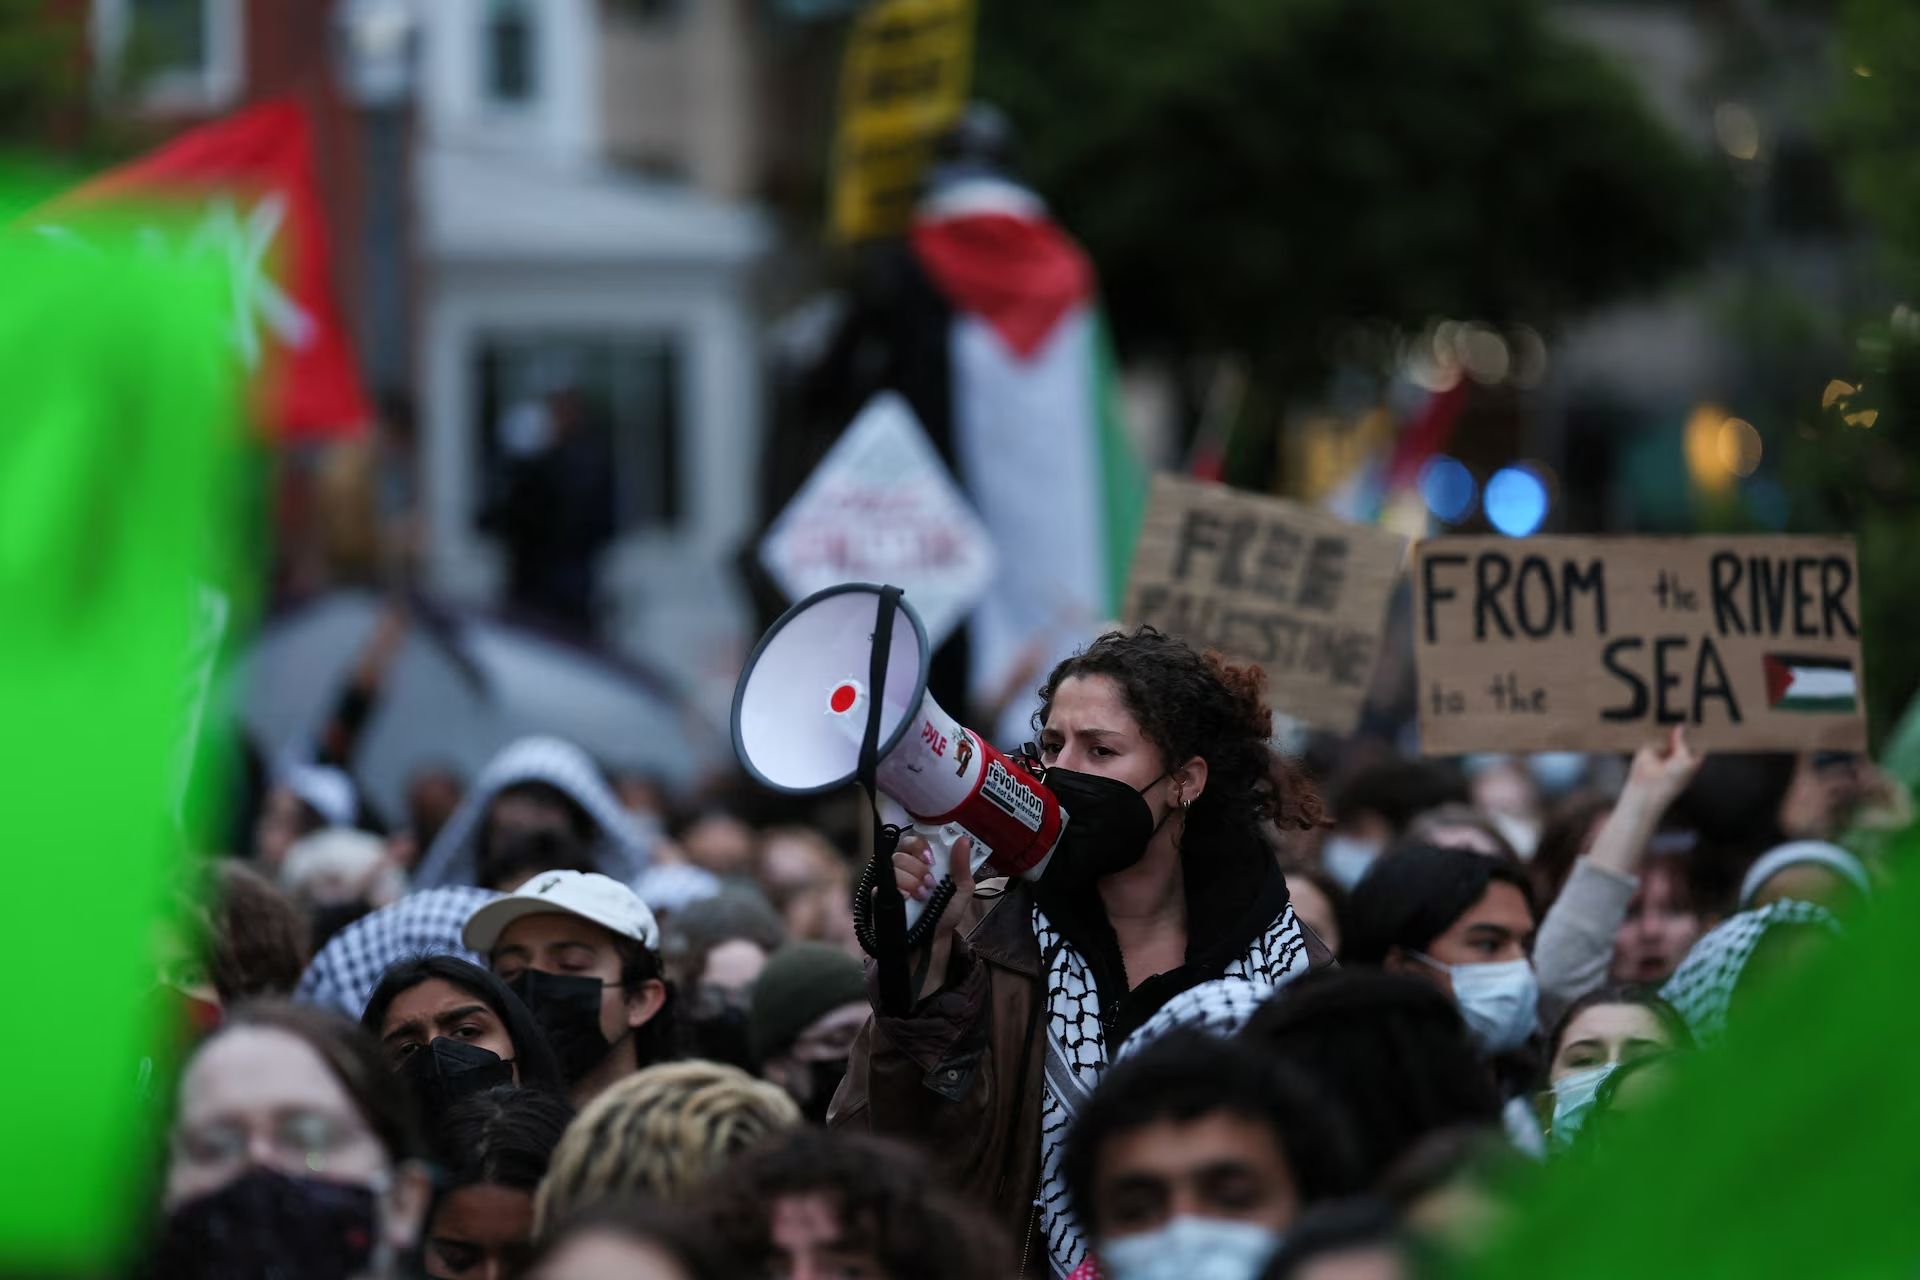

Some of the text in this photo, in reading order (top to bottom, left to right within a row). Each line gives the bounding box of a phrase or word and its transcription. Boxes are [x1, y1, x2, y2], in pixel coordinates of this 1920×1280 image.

[1171, 508, 1348, 611] FREE
[1423, 548, 1860, 644] FROM the RIVER
[1430, 635, 1743, 726] to the SEA
[921, 720, 947, 757] PYLE
[986, 780, 998, 791] will
[997, 786, 1006, 798] not
[1007, 793, 1015, 803] be
[988, 765, 1042, 813] revolution
